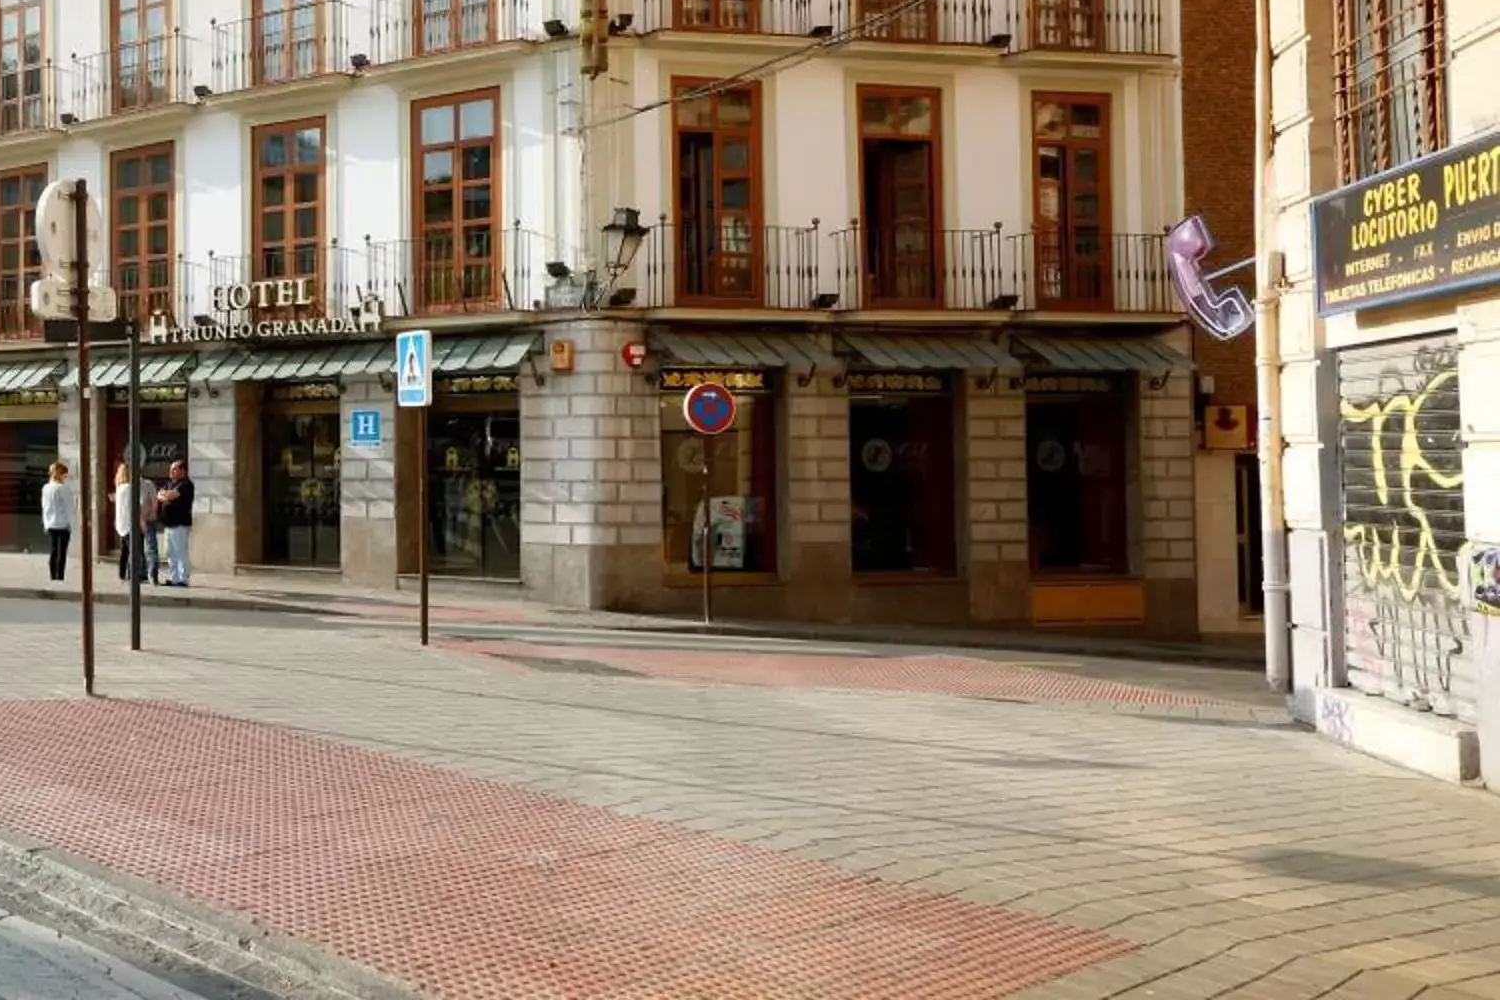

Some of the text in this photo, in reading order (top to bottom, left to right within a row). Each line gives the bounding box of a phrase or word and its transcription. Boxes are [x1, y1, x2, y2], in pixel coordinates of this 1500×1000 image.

[1363, 173, 1421, 217] CYBER
[1351, 200, 1438, 251] LOCUTORIO
[1345, 252, 1392, 278] INTERNET
[1457, 224, 1491, 248] ENVIO
[213, 277, 313, 312] HOTEL
[1368, 265, 1436, 294] TELEFONICAS
[171, 316, 361, 344] TRIUNFO GRANADA
[356, 413, 377, 435] H
